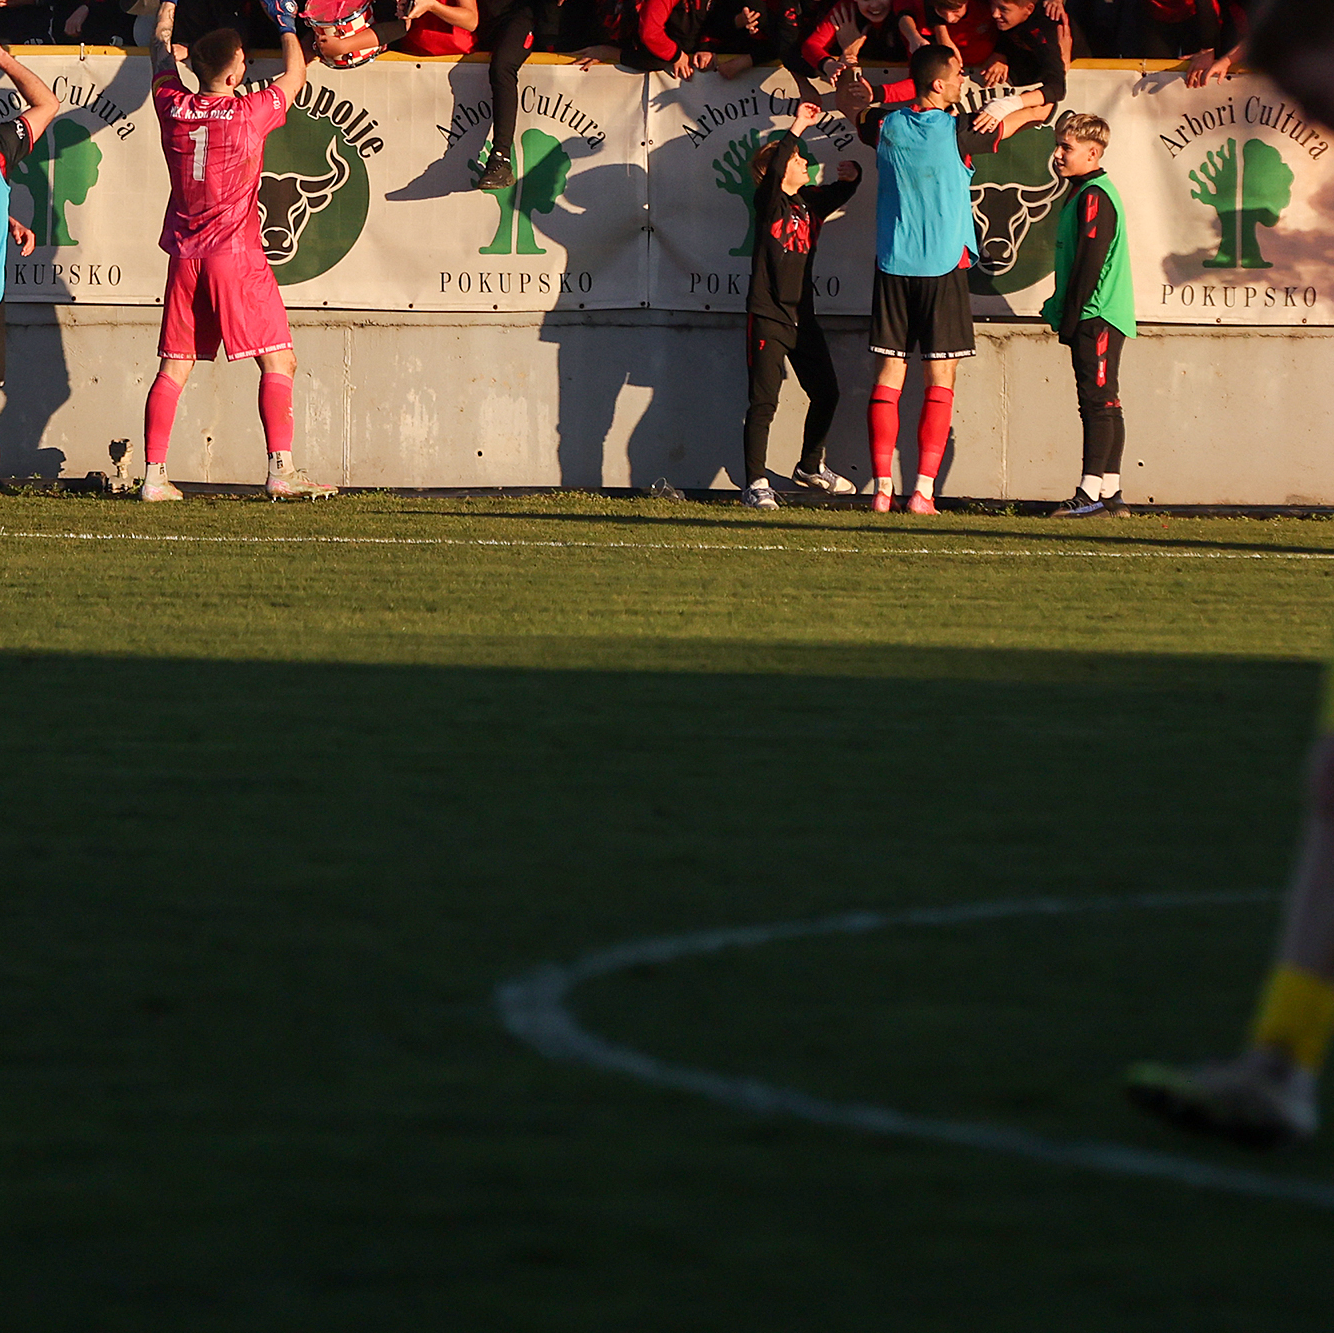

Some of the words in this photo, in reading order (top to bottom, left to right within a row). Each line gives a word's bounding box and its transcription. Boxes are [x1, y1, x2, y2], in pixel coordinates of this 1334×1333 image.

[52, 75, 136, 141] Cultura
[521, 85, 607, 151] Cultura
[682, 88, 759, 150] Arbori
[769, 87, 855, 153] Cuura
[1159, 96, 1237, 159] Arbori
[1245, 95, 1330, 161] Cultura
[188, 125, 209, 182] 1
[5, 263, 122, 288] KUPSKO
[439, 271, 593, 295] POKUPSKO
[1161, 283, 1317, 308] POKUPSKO
